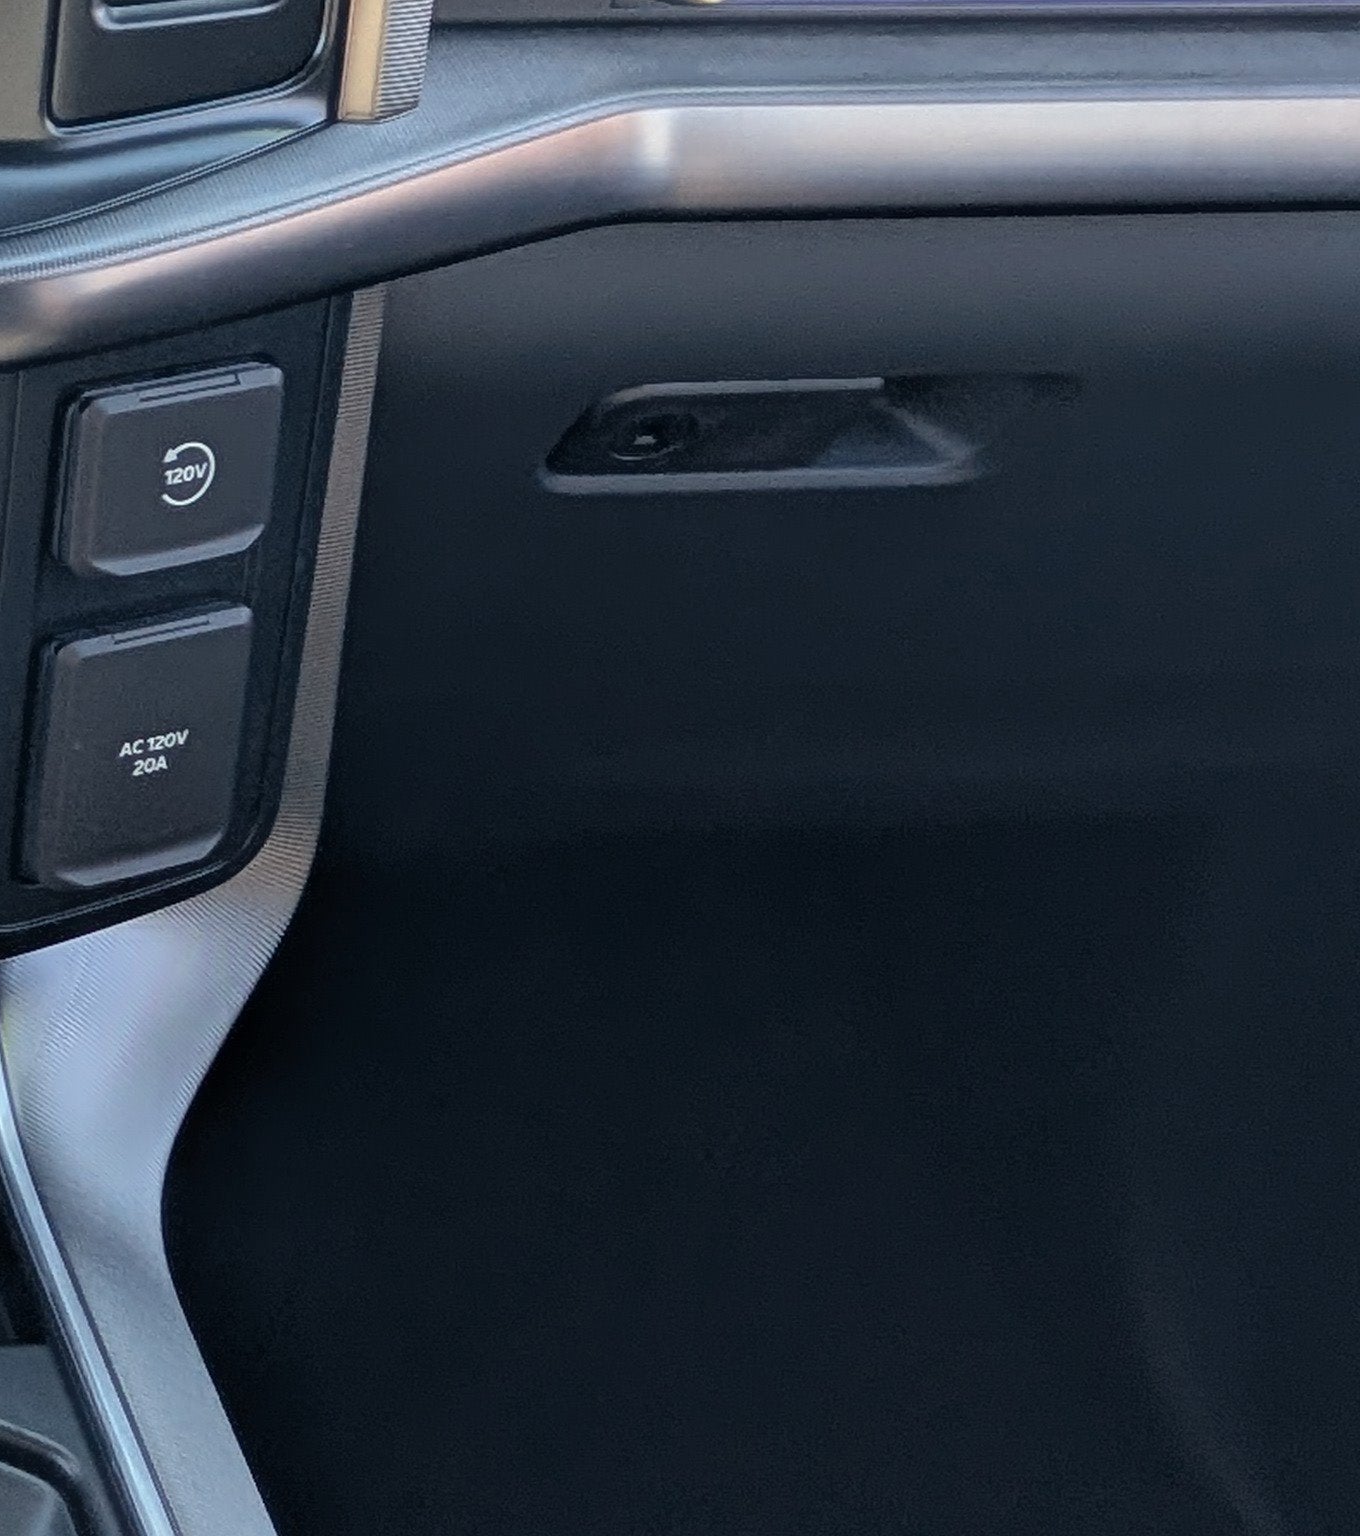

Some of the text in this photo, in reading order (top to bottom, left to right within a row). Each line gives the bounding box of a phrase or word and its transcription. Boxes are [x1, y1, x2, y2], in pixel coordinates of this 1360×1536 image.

[164, 460, 208, 486] 120V
[119, 728, 190, 757] AC 120V
[131, 755, 169, 777] 20A
